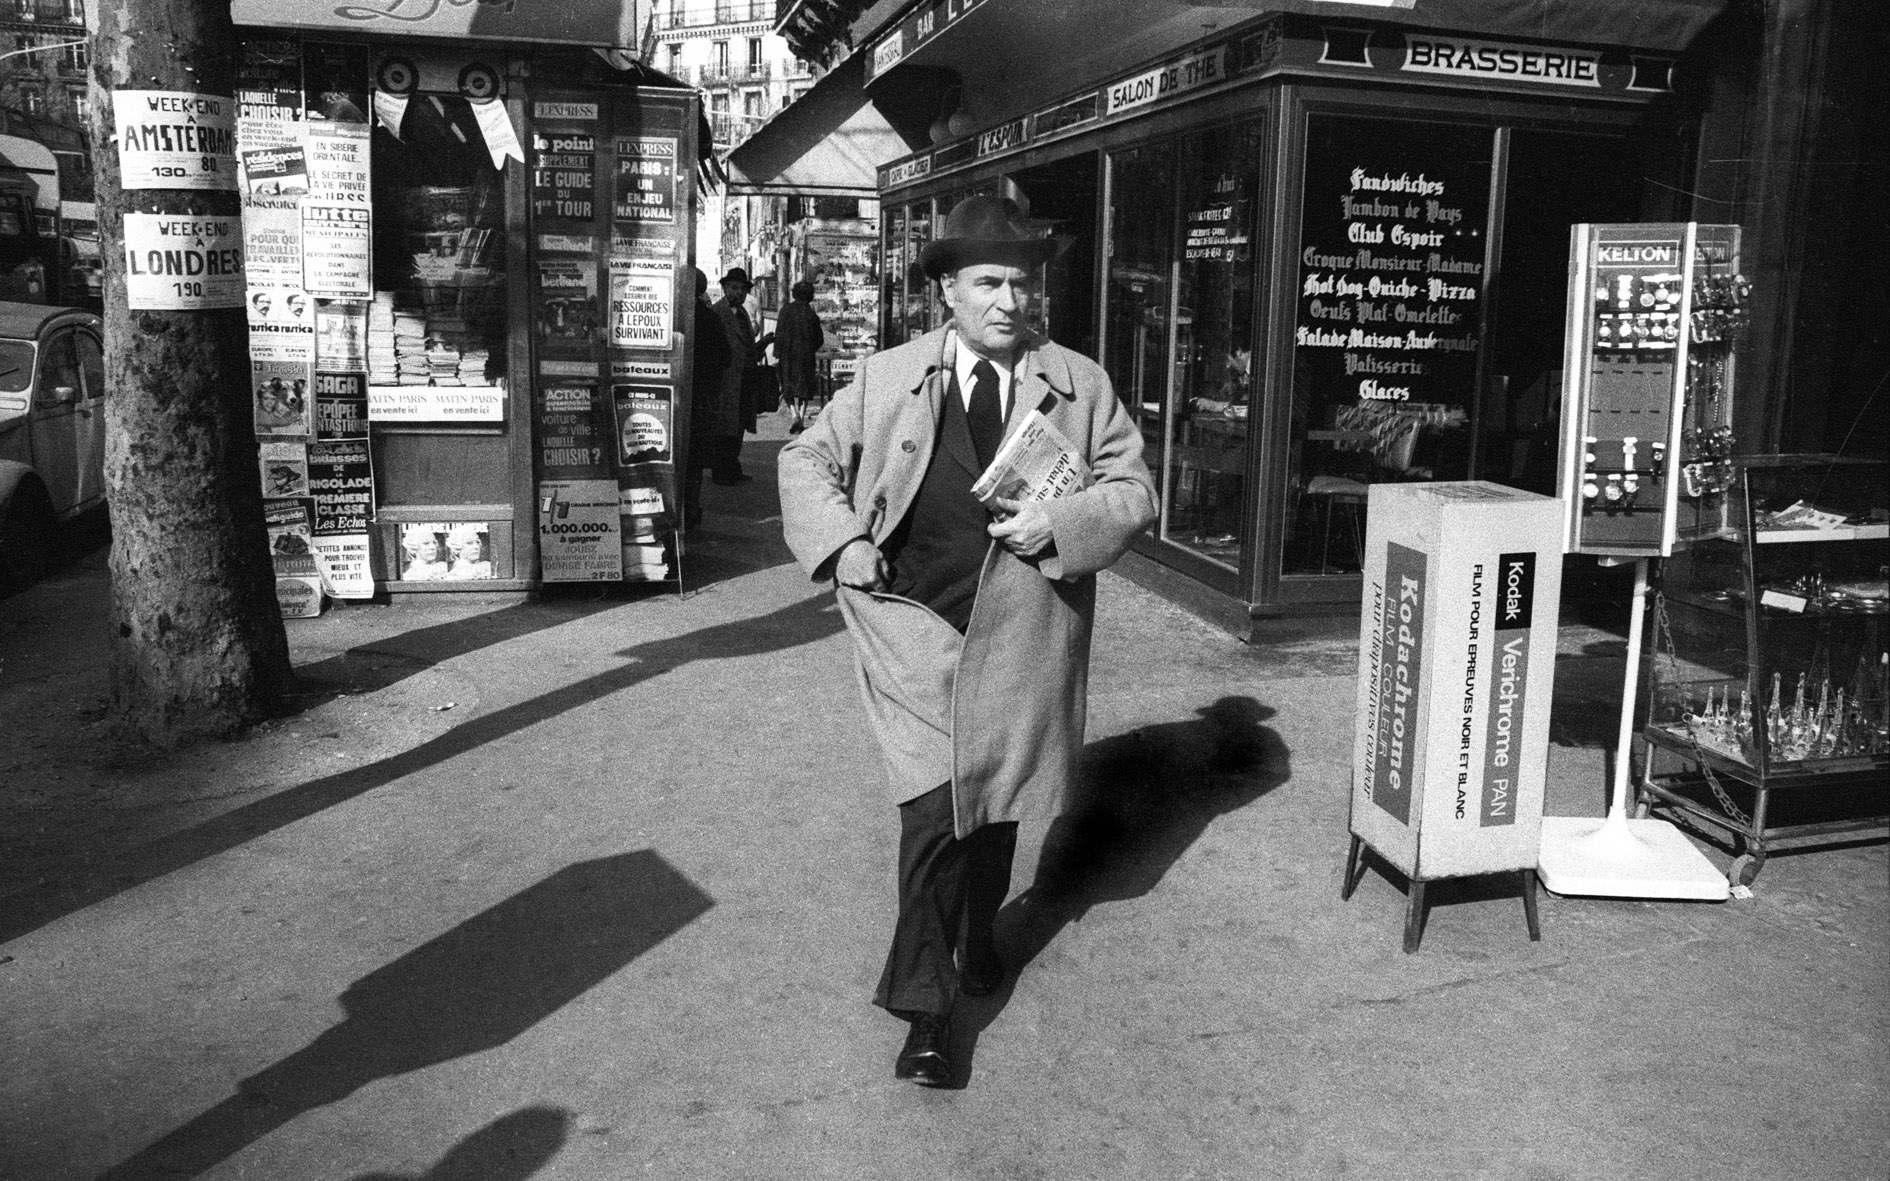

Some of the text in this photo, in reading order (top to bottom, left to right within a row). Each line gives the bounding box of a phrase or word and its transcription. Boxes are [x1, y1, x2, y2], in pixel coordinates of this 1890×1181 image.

[917, 10, 934, 40] BAR
[1411, 41, 1595, 81] BRASSERIE
[1113, 77, 1154, 108] SALON
[1159, 69, 1179, 93] DE
[125, 125, 233, 155] AMSTERDAM
[533, 134, 594, 152] le point
[981, 122, 1023, 155] L'ESPOIR
[151, 167, 186, 177] 130
[201, 156, 217, 172] 80
[621, 161, 662, 175] PARIS
[322, 171, 367, 181] SECRET DE
[535, 171, 592, 188] LE GUIDE
[637, 178, 653, 190] UN
[1350, 166, 1445, 196] Sandwiches
[558, 190, 570, 198] DU
[555, 200, 592, 217] TOUR
[617, 205, 673, 219] NATIONAL
[1341, 195, 1463, 226] Jambon de Pays
[1348, 222, 1445, 250] Club Espoir
[130, 249, 240, 276] LONDRES
[1303, 246, 1354, 272] Croque
[1598, 246, 1671, 262] KELTON
[172, 282, 202, 298] 190
[1303, 271, 1334, 297] Hot
[613, 301, 669, 314] RESSOURCES
[1310, 299, 1352, 321] Oeufs
[281, 324, 313, 334] rustica
[615, 327, 665, 340] SURVIVANT
[1296, 325, 1348, 348] Salade
[613, 366, 668, 375] bateaux
[316, 376, 358, 394] SAGA
[1359, 379, 1410, 401] Glaces
[546, 388, 590, 400] ACTION
[408, 406, 418, 414] ici
[480, 406, 490, 414] ici
[617, 402, 667, 410] bateaux
[541, 414, 577, 424] voiture
[570, 424, 591, 435] ville
[543, 436, 575, 448] LAQUELLE
[544, 448, 590, 466] CHOISIR
[1047, 453, 1070, 485] débat
[1061, 467, 1078, 486] Un
[309, 477, 372, 489] RIGOLADE
[319, 504, 366, 515] CLASSE
[315, 516, 367, 530] Les Echos
[560, 534, 601, 544] à gagner
[1505, 562, 1524, 621] Kodak
[1378, 597, 1397, 758] FILM COULEUR
[1389, 574, 1419, 790] Kodachrome
[1363, 581, 1383, 800] pour diapositives couleur
[1455, 564, 1483, 820] FILM POUR EPREUVES NOIR ET BLANC
[1490, 637, 1524, 816] Verichrome PAN
